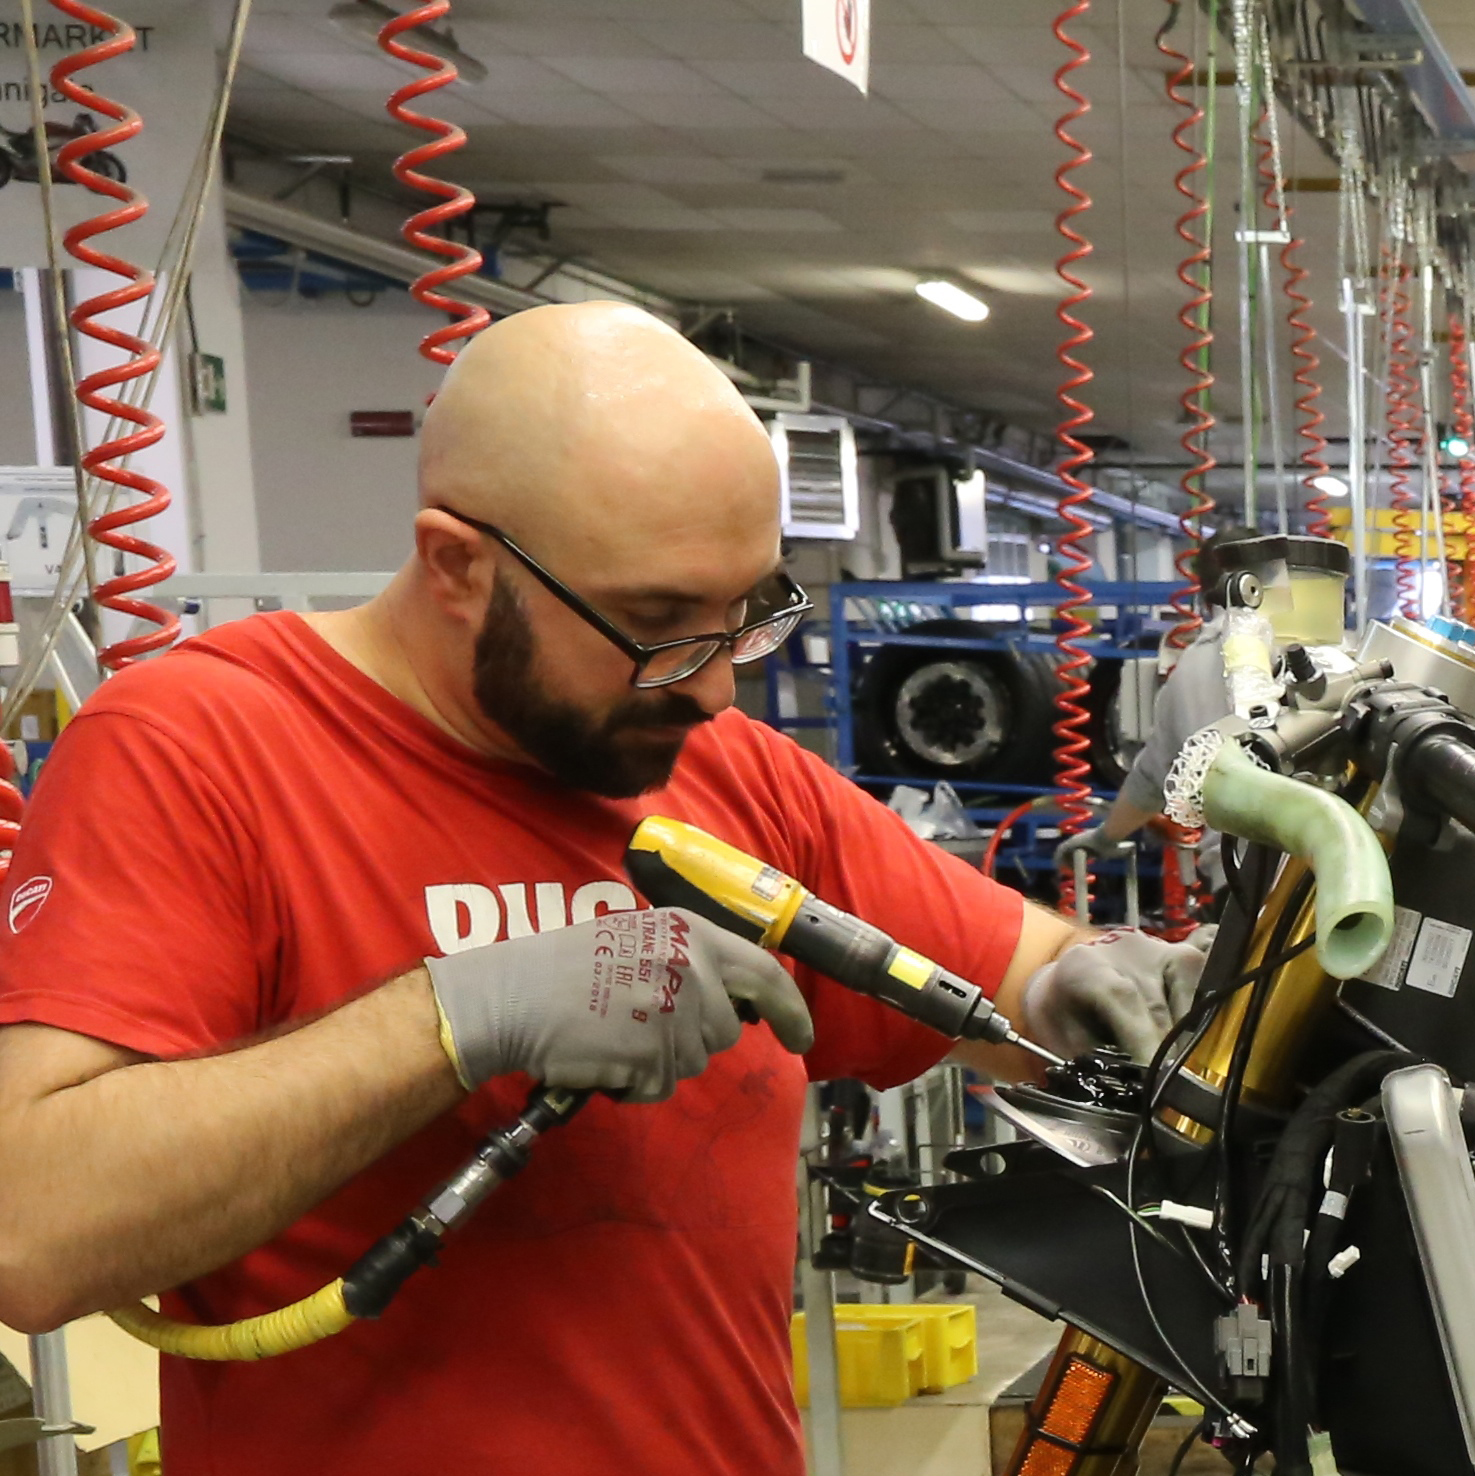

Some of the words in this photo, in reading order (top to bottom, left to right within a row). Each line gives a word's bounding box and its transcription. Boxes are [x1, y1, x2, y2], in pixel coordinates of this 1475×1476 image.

[0, 24, 153, 50] RMARKT
[425, 881, 637, 955] DUC
[638, 958, 652, 983] 551
[659, 911, 690, 1014] MAPA
